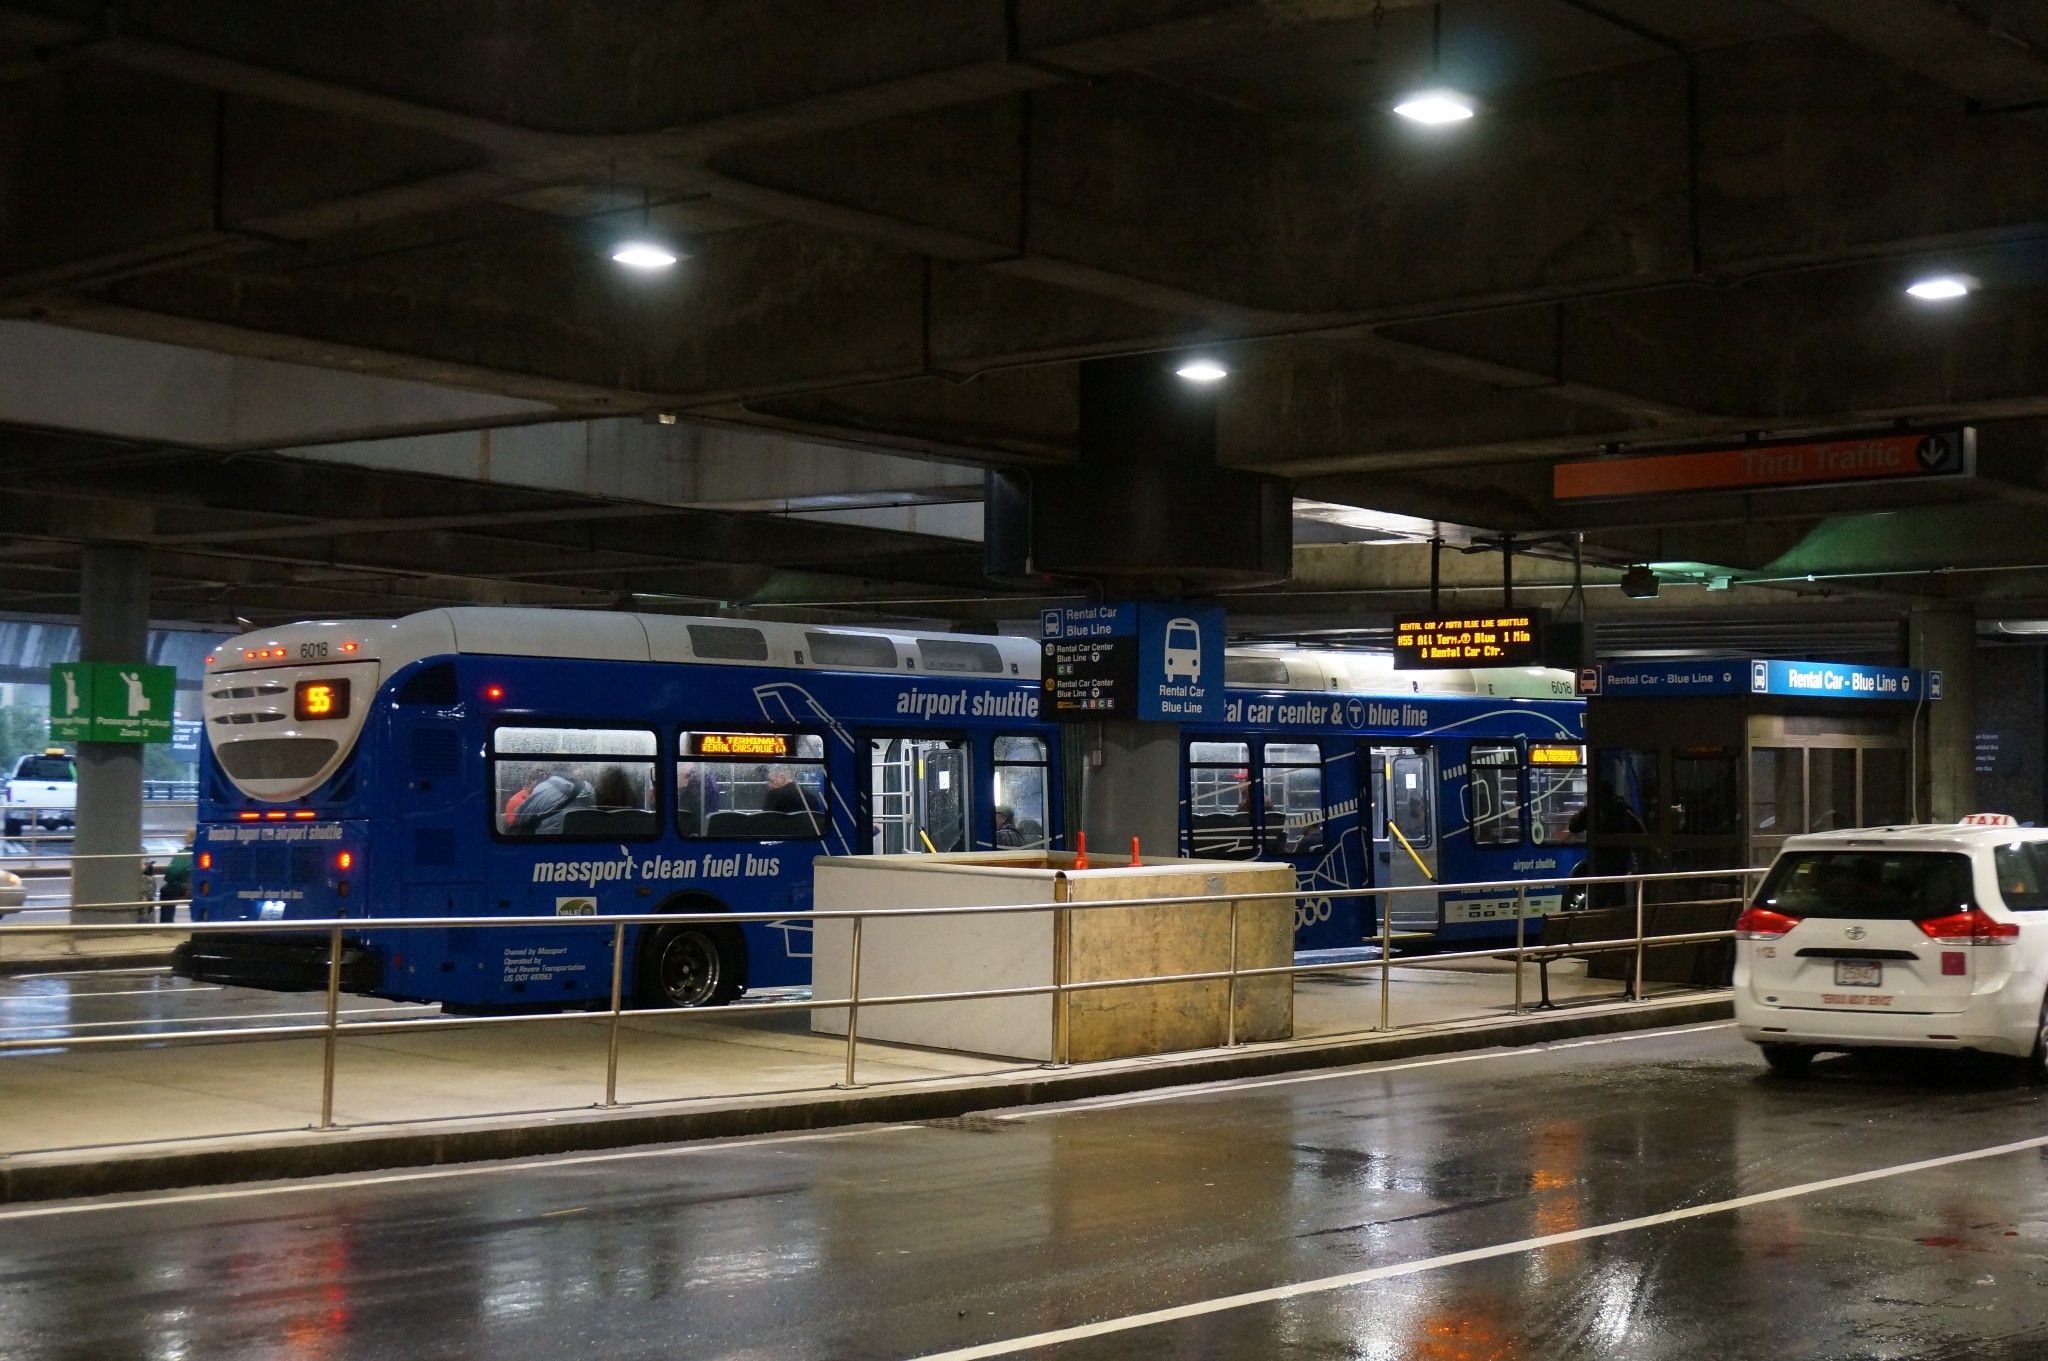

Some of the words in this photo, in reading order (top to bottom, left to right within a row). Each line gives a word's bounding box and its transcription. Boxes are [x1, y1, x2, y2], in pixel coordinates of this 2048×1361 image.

[1741, 450, 1803, 476] Thru
[1813, 442, 1901, 471] Traffic
[1066, 608, 1097, 620] Rental
[1100, 607, 1117, 618] Car
[1067, 625, 1088, 636] Blue
[1091, 624, 1112, 635] Line
[1424, 622, 1436, 630] CAR
[1445, 621, 1462, 629] MBTA
[1464, 620, 1479, 628] BLUE
[1481, 619, 1495, 627] LINE
[1497, 618, 1529, 626] SHUTTLES
[1398, 635, 1413, 646] #55
[1417, 635, 1432, 645] All
[1474, 633, 1495, 643] Blue
[1504, 631, 1509, 642] 1
[1513, 631, 1530, 642] Min
[301, 642, 328, 658] 6018
[1057, 645, 1077, 653] Rental
[1092, 643, 1114, 651] Center
[1431, 647, 1460, 658] Rental
[1464, 646, 1481, 657] Car
[1484, 646, 1505, 656] Ctr.
[1057, 655, 1071, 663] Blue
[1059, 665, 1065, 674] C
[1066, 665, 1072, 674] E
[1057, 680, 1077, 688] Rental
[1092, 679, 1114, 687] Center
[1608, 675, 1638, 685] Rental
[1641, 674, 1658, 684] Car
[1667, 674, 1690, 683] Blue
[1692, 673, 1714, 683] Line
[1789, 669, 1822, 689] Rental
[1824, 671, 1844, 690] Car
[1852, 672, 1875, 691] Blue
[1876, 674, 1896, 692] Line
[1057, 690, 1071, 698] Blue
[1073, 689, 1087, 697] Line
[1160, 685, 1187, 697] Rental
[1189, 686, 1205, 697] Car
[1551, 681, 1572, 694] 6018
[308, 687, 330, 713] 55
[896, 687, 967, 721] airport
[972, 690, 1039, 718] shuttle
[1082, 700, 1088, 708] A
[1090, 700, 1096, 708] B
[1098, 700, 1105, 708] C
[1107, 699, 1113, 707] E
[1162, 701, 1181, 712] Blue
[1184, 702, 1202, 713] Line
[1247, 704, 1275, 723] car
[1278, 701, 1327, 724] center
[1331, 702, 1343, 724] &
[1368, 703, 1399, 726] blue
[1402, 704, 1428, 727] line
[97, 717, 140, 727] Passenger
[142, 718, 170, 727] Pickup
[120, 729, 141, 737] Zone
[704, 736, 723, 744] ALL
[702, 743, 730, 752] RENTAL
[732, 744, 773, 753] CARS/BLUE
[1966, 815, 2008, 825] TAXI
[275, 825, 307, 843] airport
[532, 853, 634, 888] massport
[641, 855, 696, 879] clean
[702, 854, 741, 878] fuel
[745, 854, 780, 877] bus
[1513, 860, 1534, 872] airport
[1535, 859, 1556, 869] shuttle
[504, 948, 527, 956] Owned
[528, 948, 536, 956] by
[504, 957, 533, 965] Operated
[534, 957, 542, 965] by
[542, 964, 586, 972] Transportation
[504, 974, 514, 982] US
[515, 974, 529, 982] DOT
